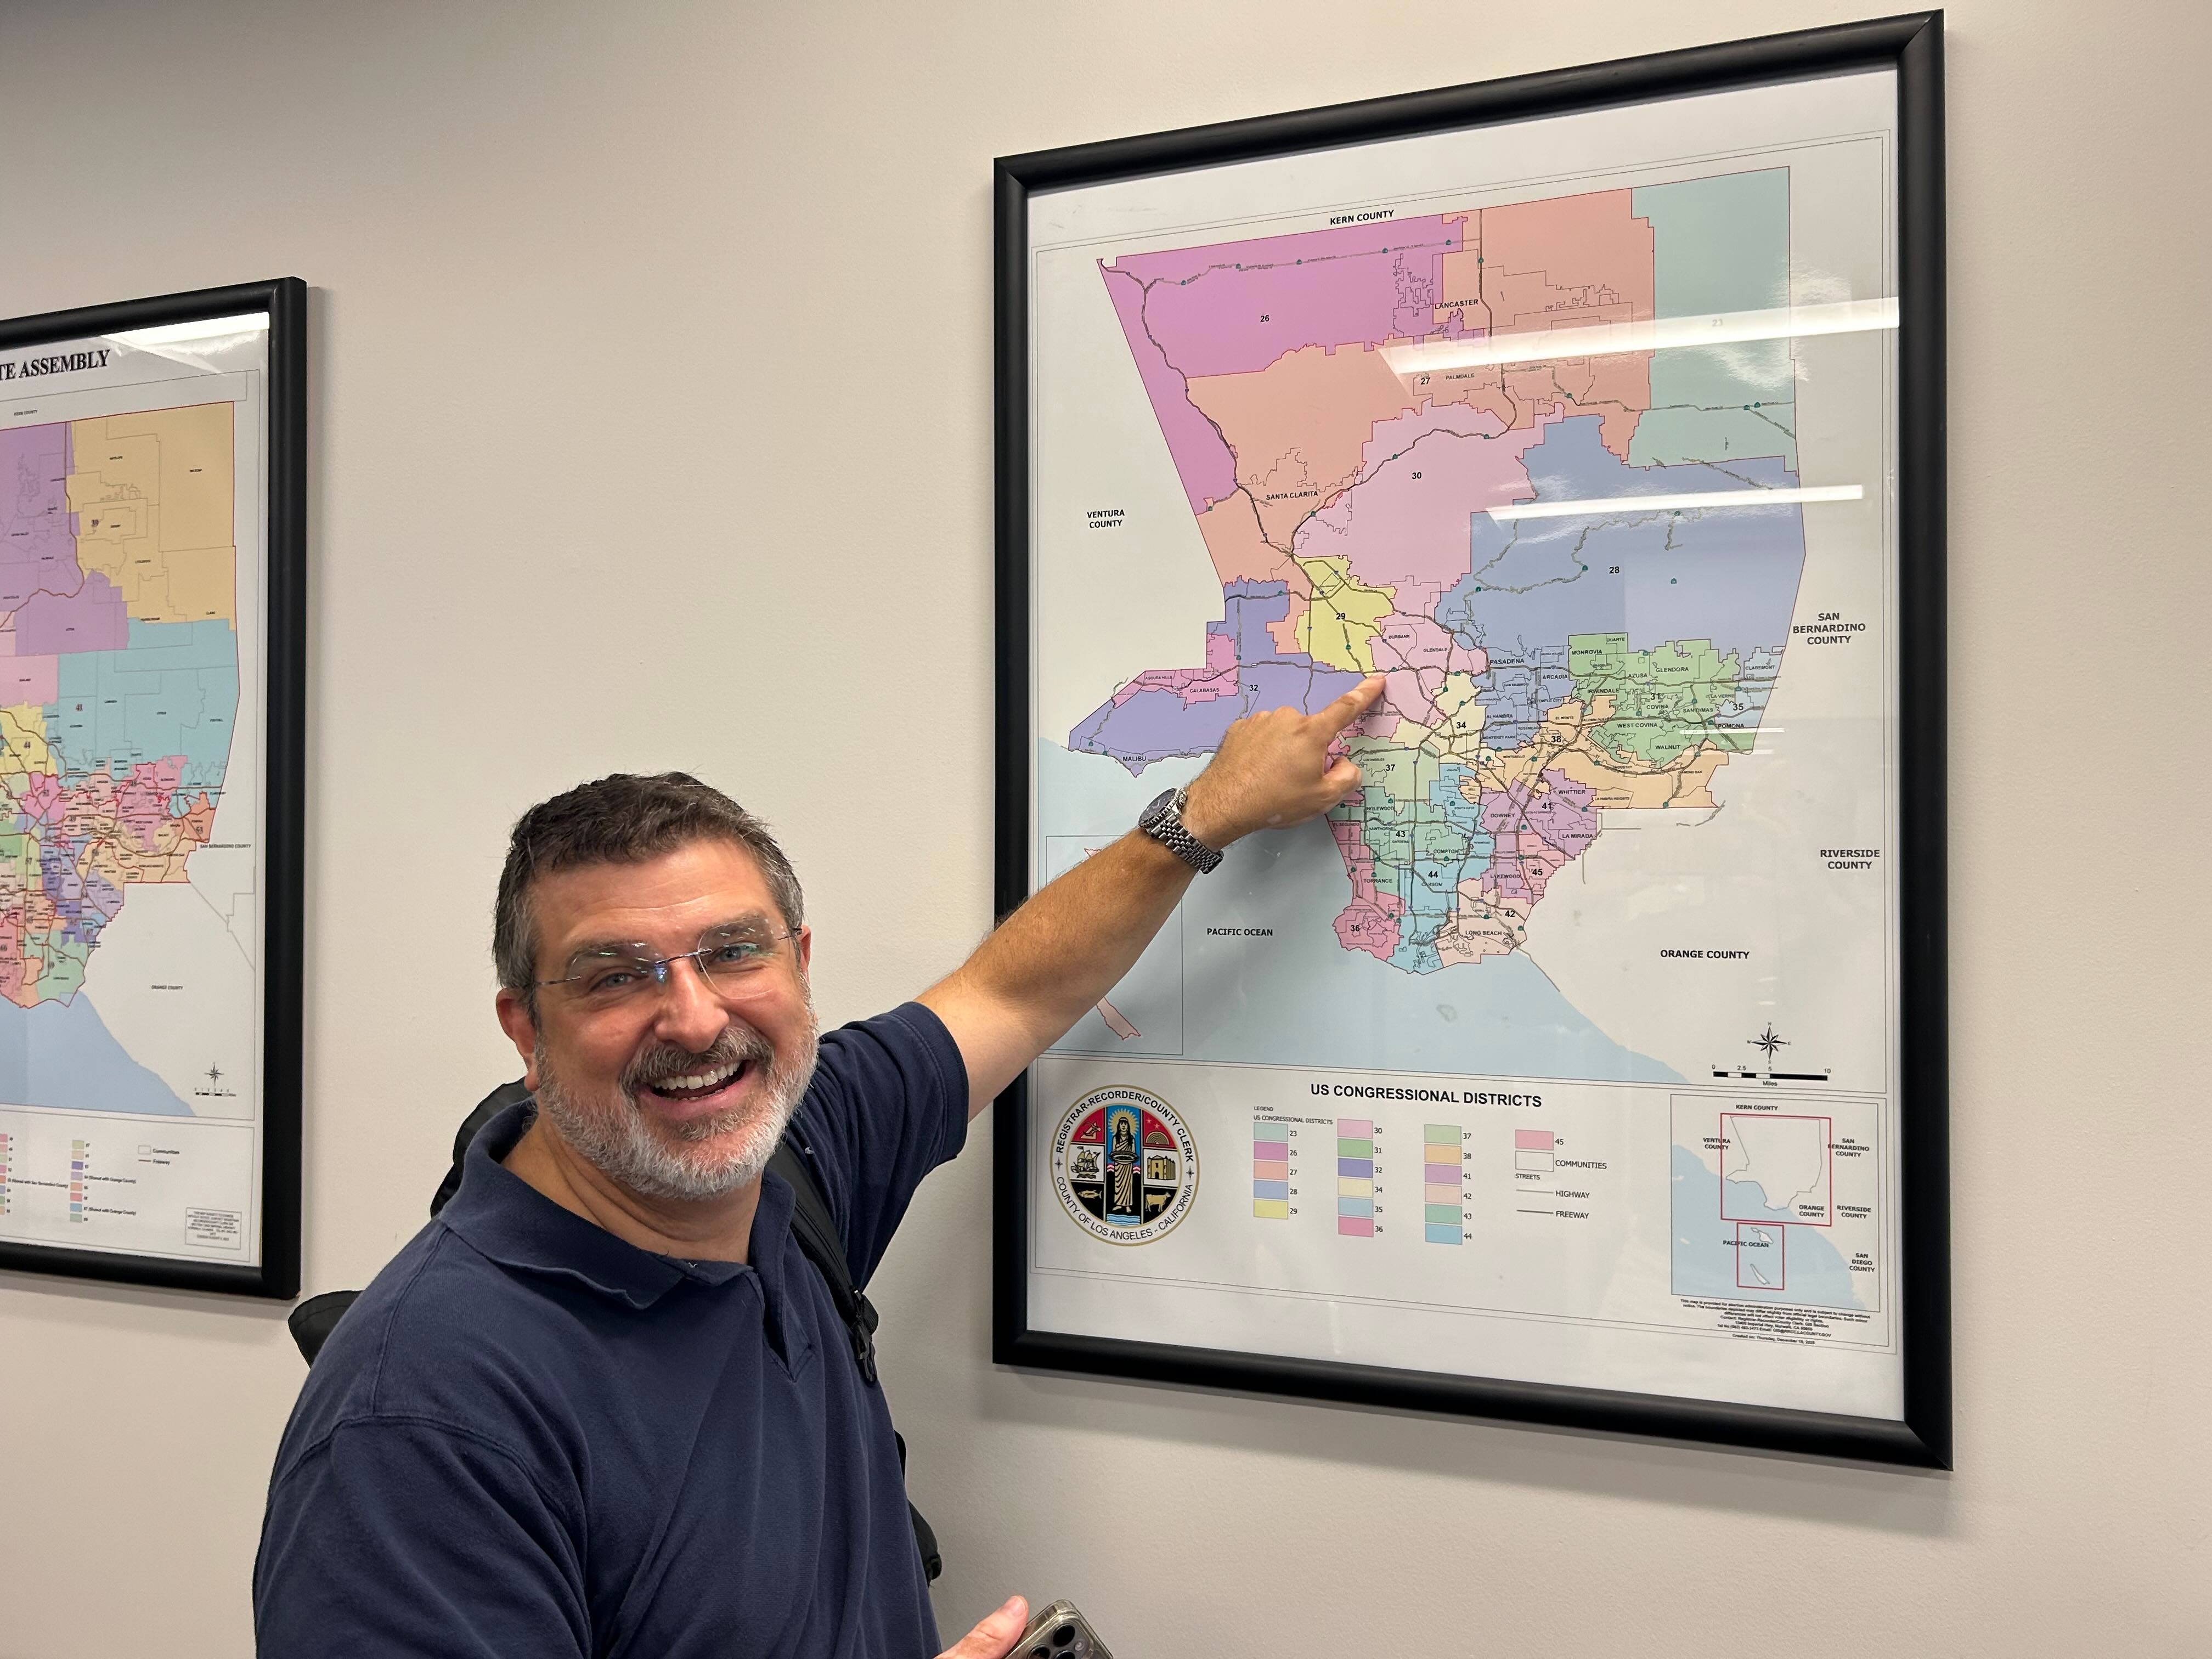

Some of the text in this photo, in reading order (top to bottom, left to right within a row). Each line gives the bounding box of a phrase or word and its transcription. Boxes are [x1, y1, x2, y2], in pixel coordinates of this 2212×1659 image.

[1330, 210, 1395, 225] KERN COUNTY
[1435, 300, 1479, 309] LANCASTER
[1260, 314, 1269, 323] 26
[19, 349, 110, 378] ASSEMBLY
[1087, 509, 1125, 518] VENTURA
[1090, 520, 1122, 528] COUNTY
[1793, 624, 1866, 633] BERNARDINO
[1807, 636, 1851, 645] COUNTY
[1820, 850, 1880, 858] RIVERSIDE
[1827, 861, 1872, 870] COUNTY
[1661, 950, 1750, 960] ORANGE COUNTY
[1311, 1084, 1542, 1107] US CONGRESSIONAL DISTRICTS
[1057, 1090, 1193, 1163] REGISTRAR-RECORDER/COUNTY CLERK
[1555, 1160, 1607, 1169] COMMUNITIES
[1556, 1190, 1590, 1199] HIGHWAY
[1057, 1177, 1193, 1240] COUNTY OF LOS ANGELES CALIFORNIA
[1556, 1211, 1589, 1219] FREEWAY
